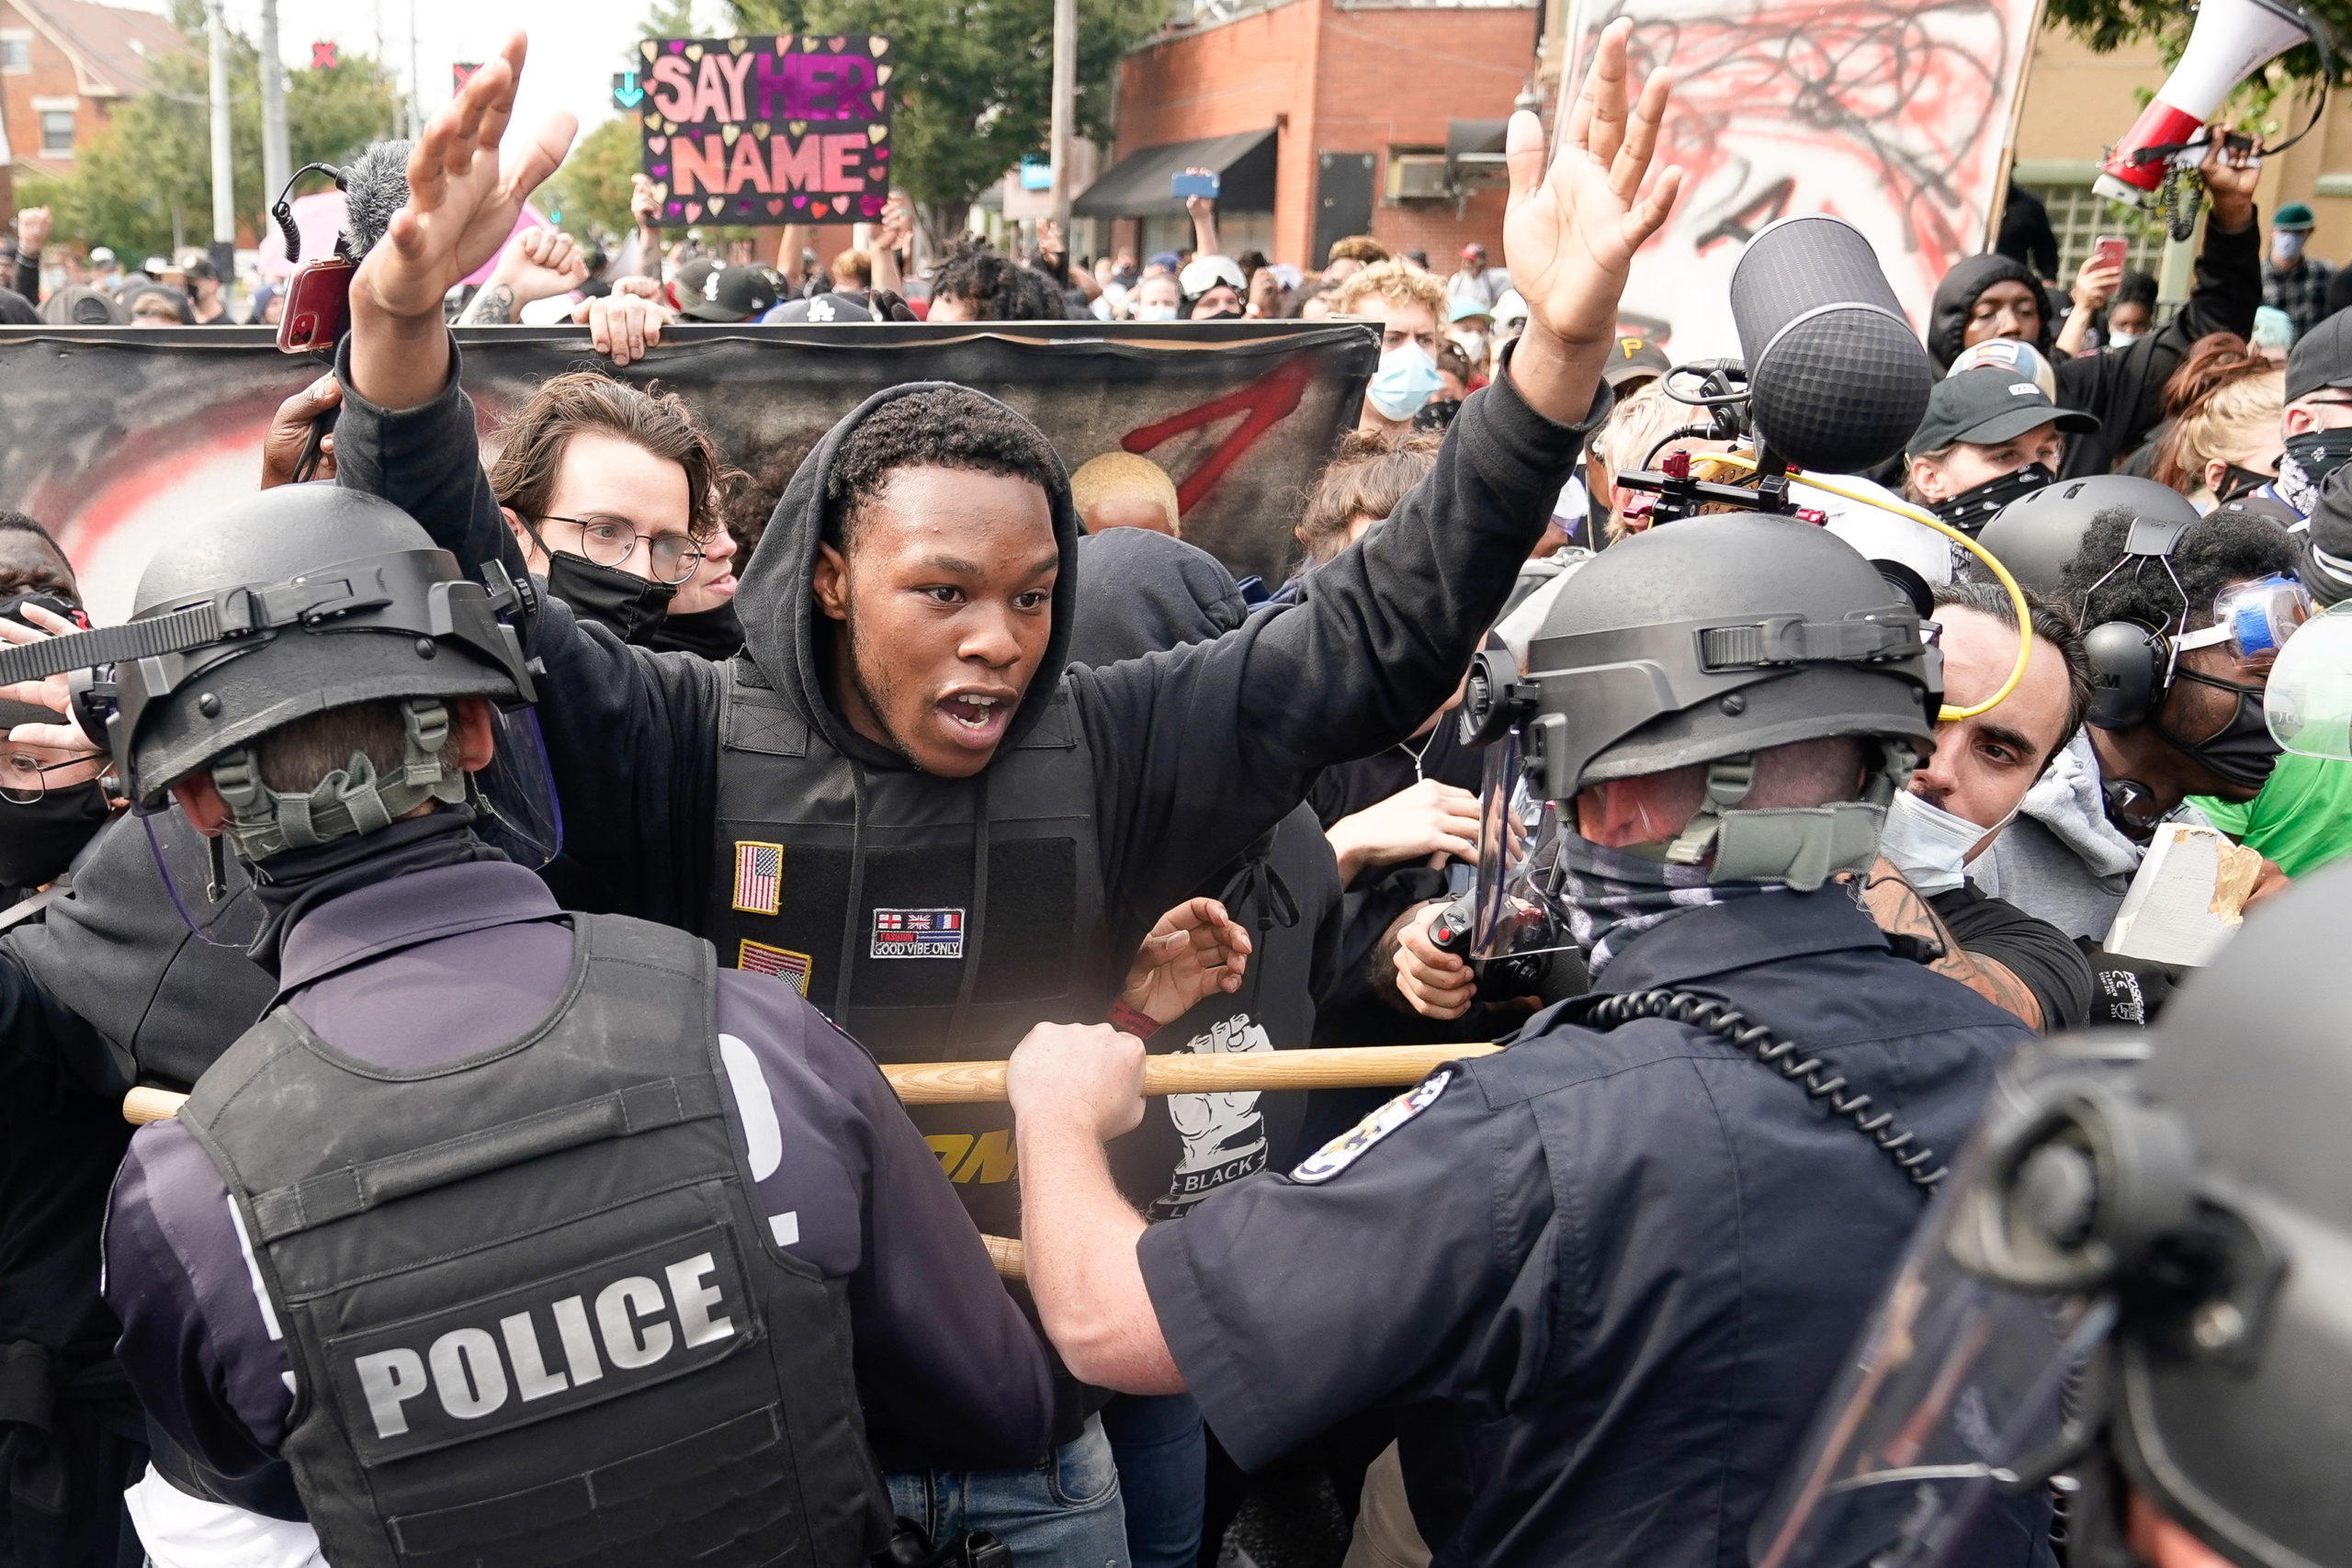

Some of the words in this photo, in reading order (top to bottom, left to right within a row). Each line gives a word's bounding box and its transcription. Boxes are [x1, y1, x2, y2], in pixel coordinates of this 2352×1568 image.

[652, 51, 755, 123] SAY
[757, 52, 876, 120] HER
[671, 132, 868, 196] NAME
[1621, 338, 1644, 359] P
[876, 943, 904, 955] GOOD
[908, 942, 930, 954] VIBE
[933, 942, 959, 954] ONLY
[1184, 1155, 1253, 1191] BLACK
[355, 1252, 735, 1438] POLICE
